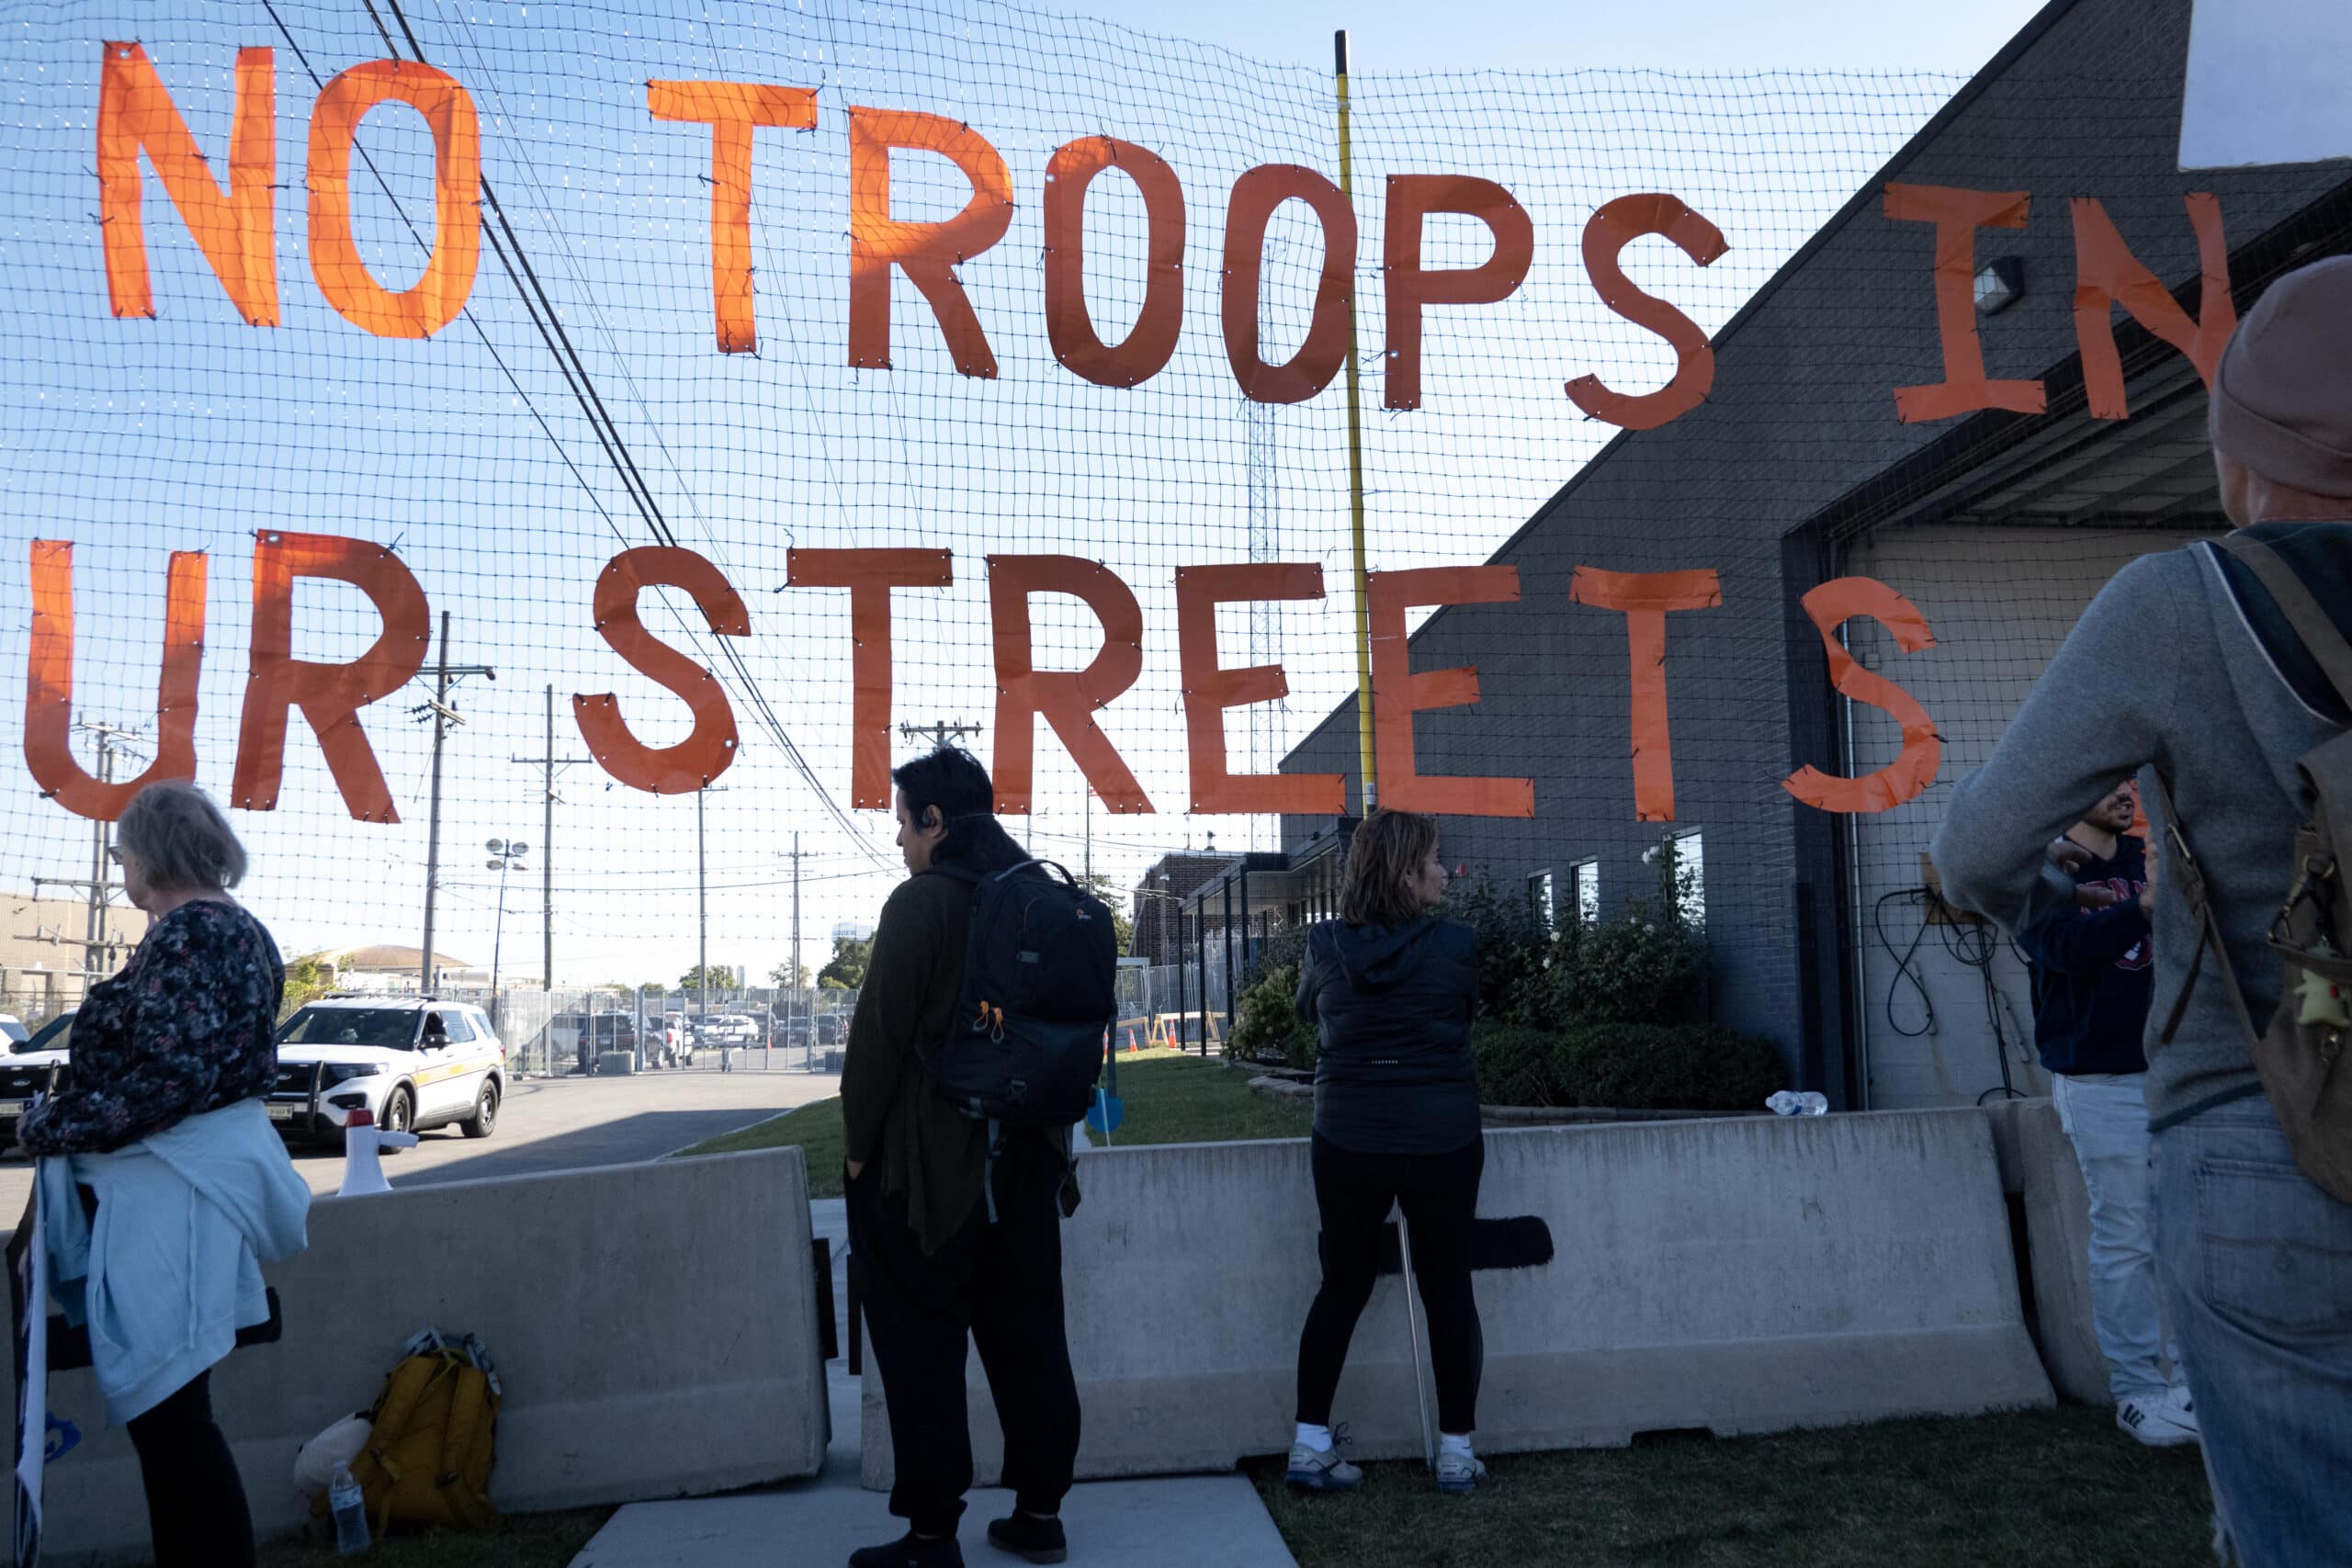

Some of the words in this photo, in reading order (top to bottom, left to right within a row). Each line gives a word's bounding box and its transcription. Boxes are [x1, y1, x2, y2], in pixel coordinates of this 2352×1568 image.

[96, 40, 482, 339] NO
[647, 79, 1731, 430] TROOPS
[1883, 183, 2238, 422] IN
[573, 546, 1941, 823] STREETS
